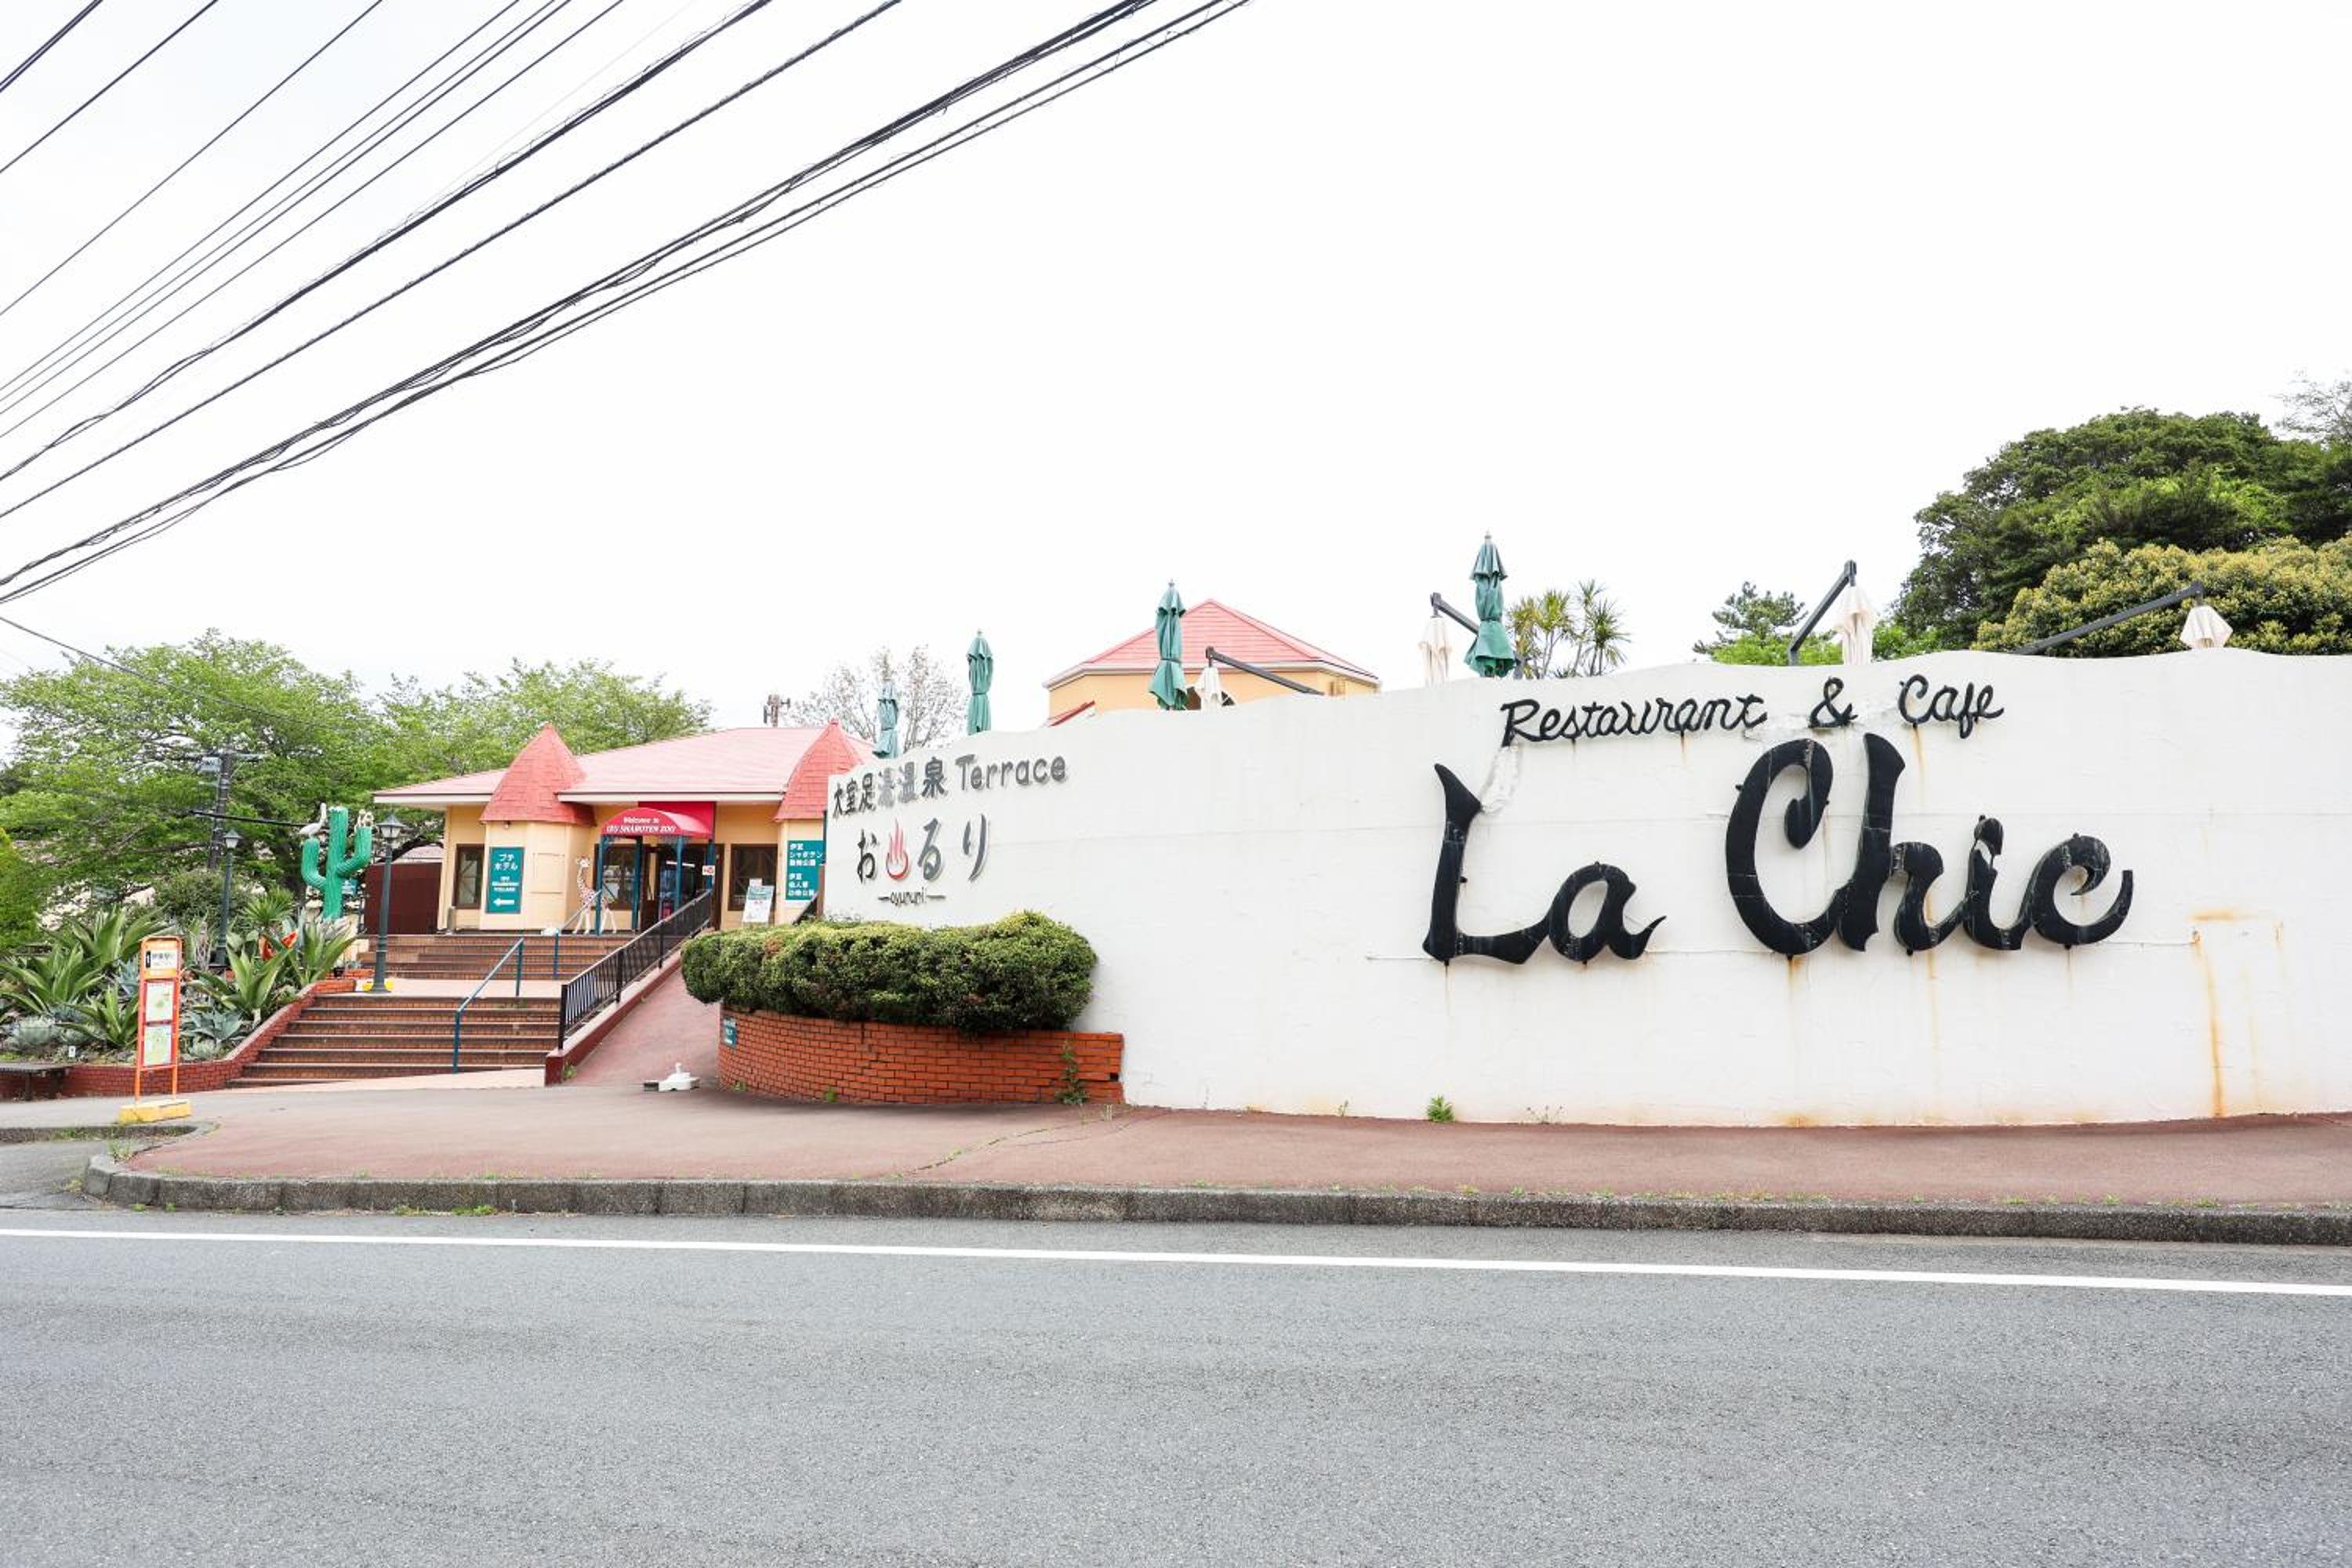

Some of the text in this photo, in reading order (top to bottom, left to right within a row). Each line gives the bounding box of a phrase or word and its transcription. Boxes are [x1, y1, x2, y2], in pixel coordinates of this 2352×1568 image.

[1501, 673, 2005, 747] Restaurant & Cafe
[955, 753, 1066, 791] Terrace
[623, 815, 650, 824] Welcome
[494, 862, 518, 871] ホテル
[1422, 732, 2133, 965] La Chic
